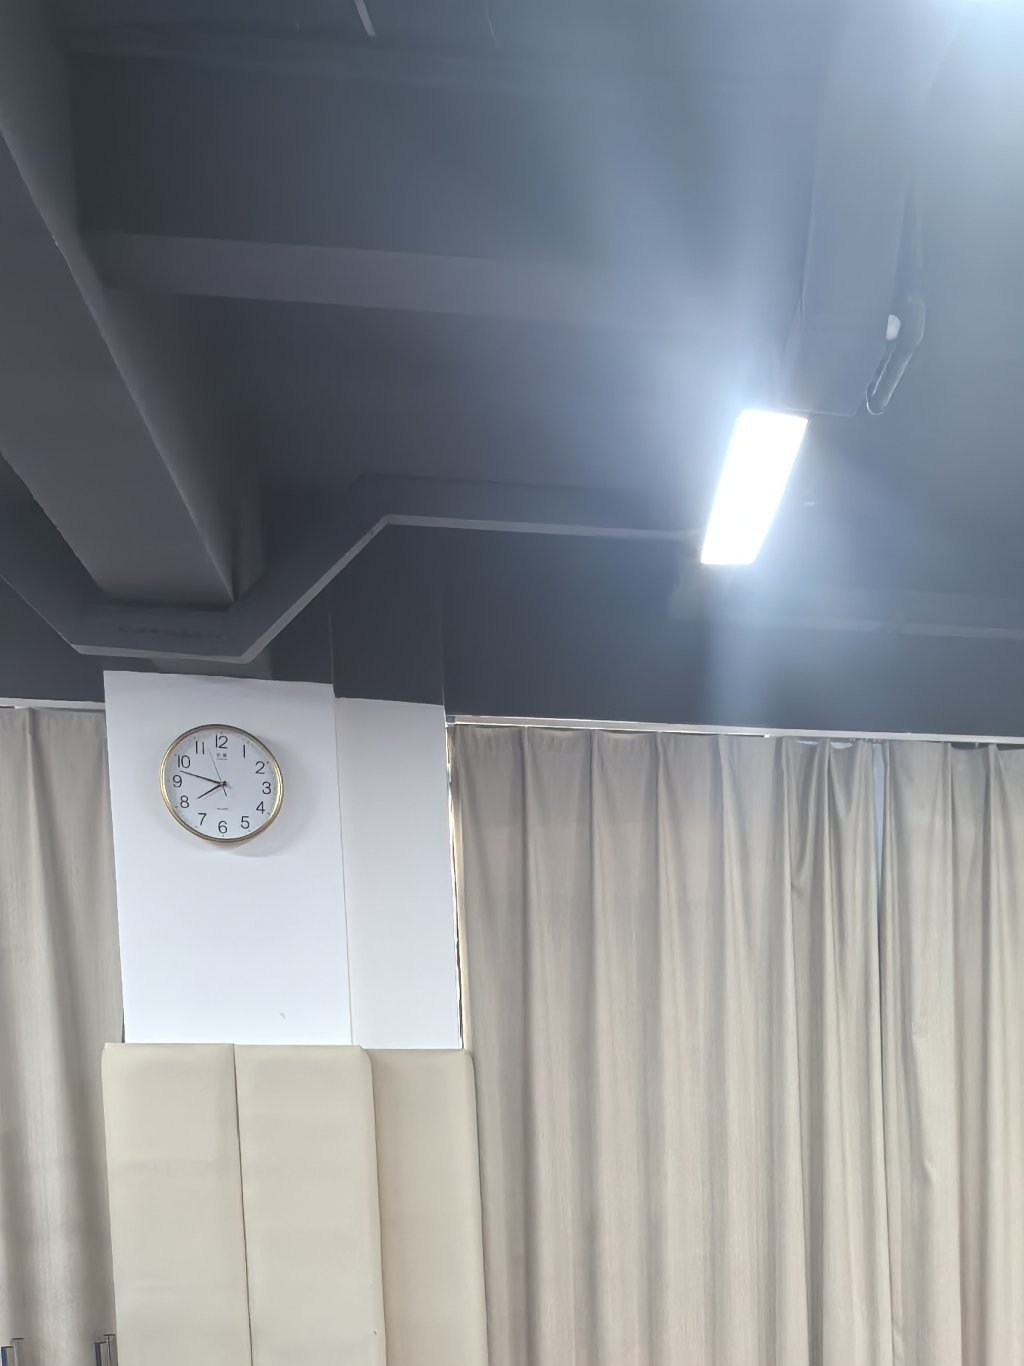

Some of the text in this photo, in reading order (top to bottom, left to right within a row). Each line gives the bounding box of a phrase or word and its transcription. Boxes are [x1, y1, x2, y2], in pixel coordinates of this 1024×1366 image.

[195, 740, 205, 755] 11
[215, 734, 228, 749] 12
[177, 754, 191, 768] 10
[255, 761, 265, 774] 2
[172, 774, 182, 788] 9
[262, 781, 272, 795] 3
[180, 795, 190, 808] 8
[256, 801, 265, 814] 4
[198, 812, 207, 826] 7
[241, 816, 250, 829] 5
[218, 820, 228, 834] 6
